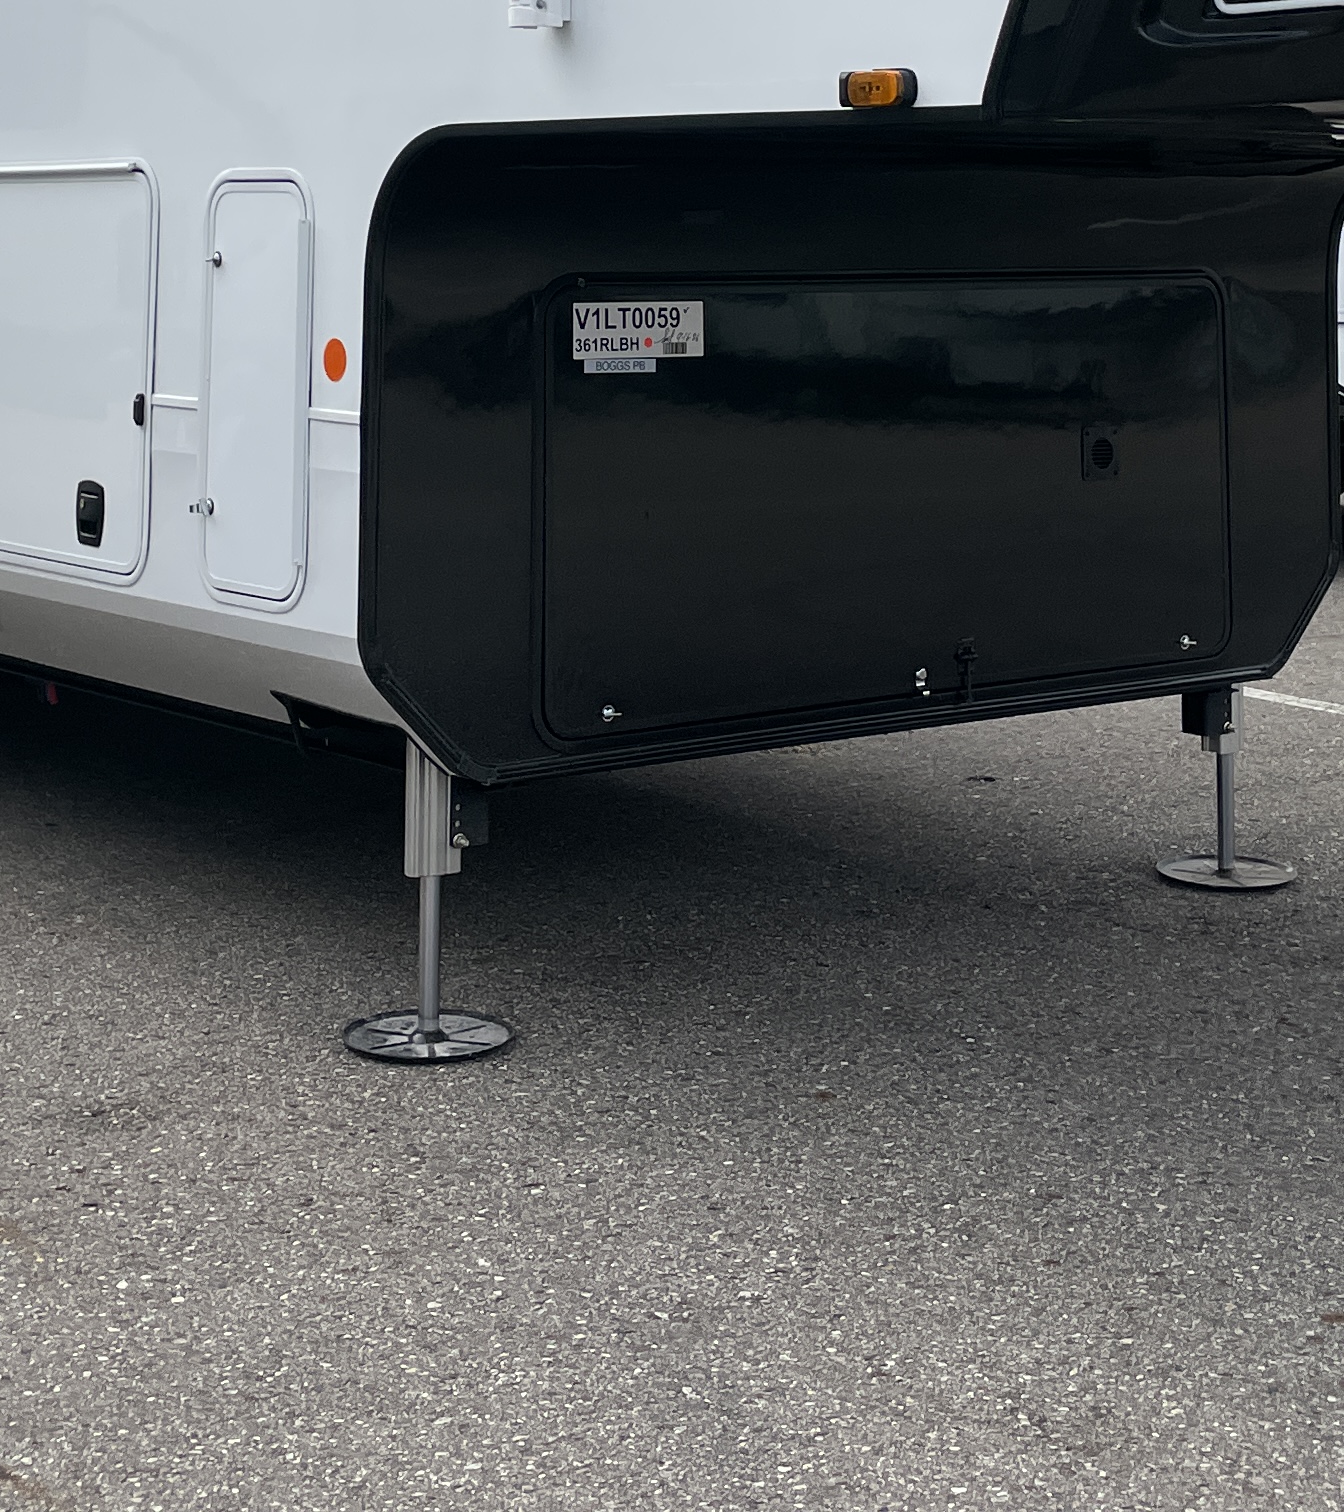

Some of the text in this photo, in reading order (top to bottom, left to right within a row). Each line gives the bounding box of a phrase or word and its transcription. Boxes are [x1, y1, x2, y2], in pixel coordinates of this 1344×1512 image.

[575, 306, 681, 330] V1LT0059
[574, 336, 640, 353] 361RLBH
[595, 360, 646, 372] BOGGS PB
